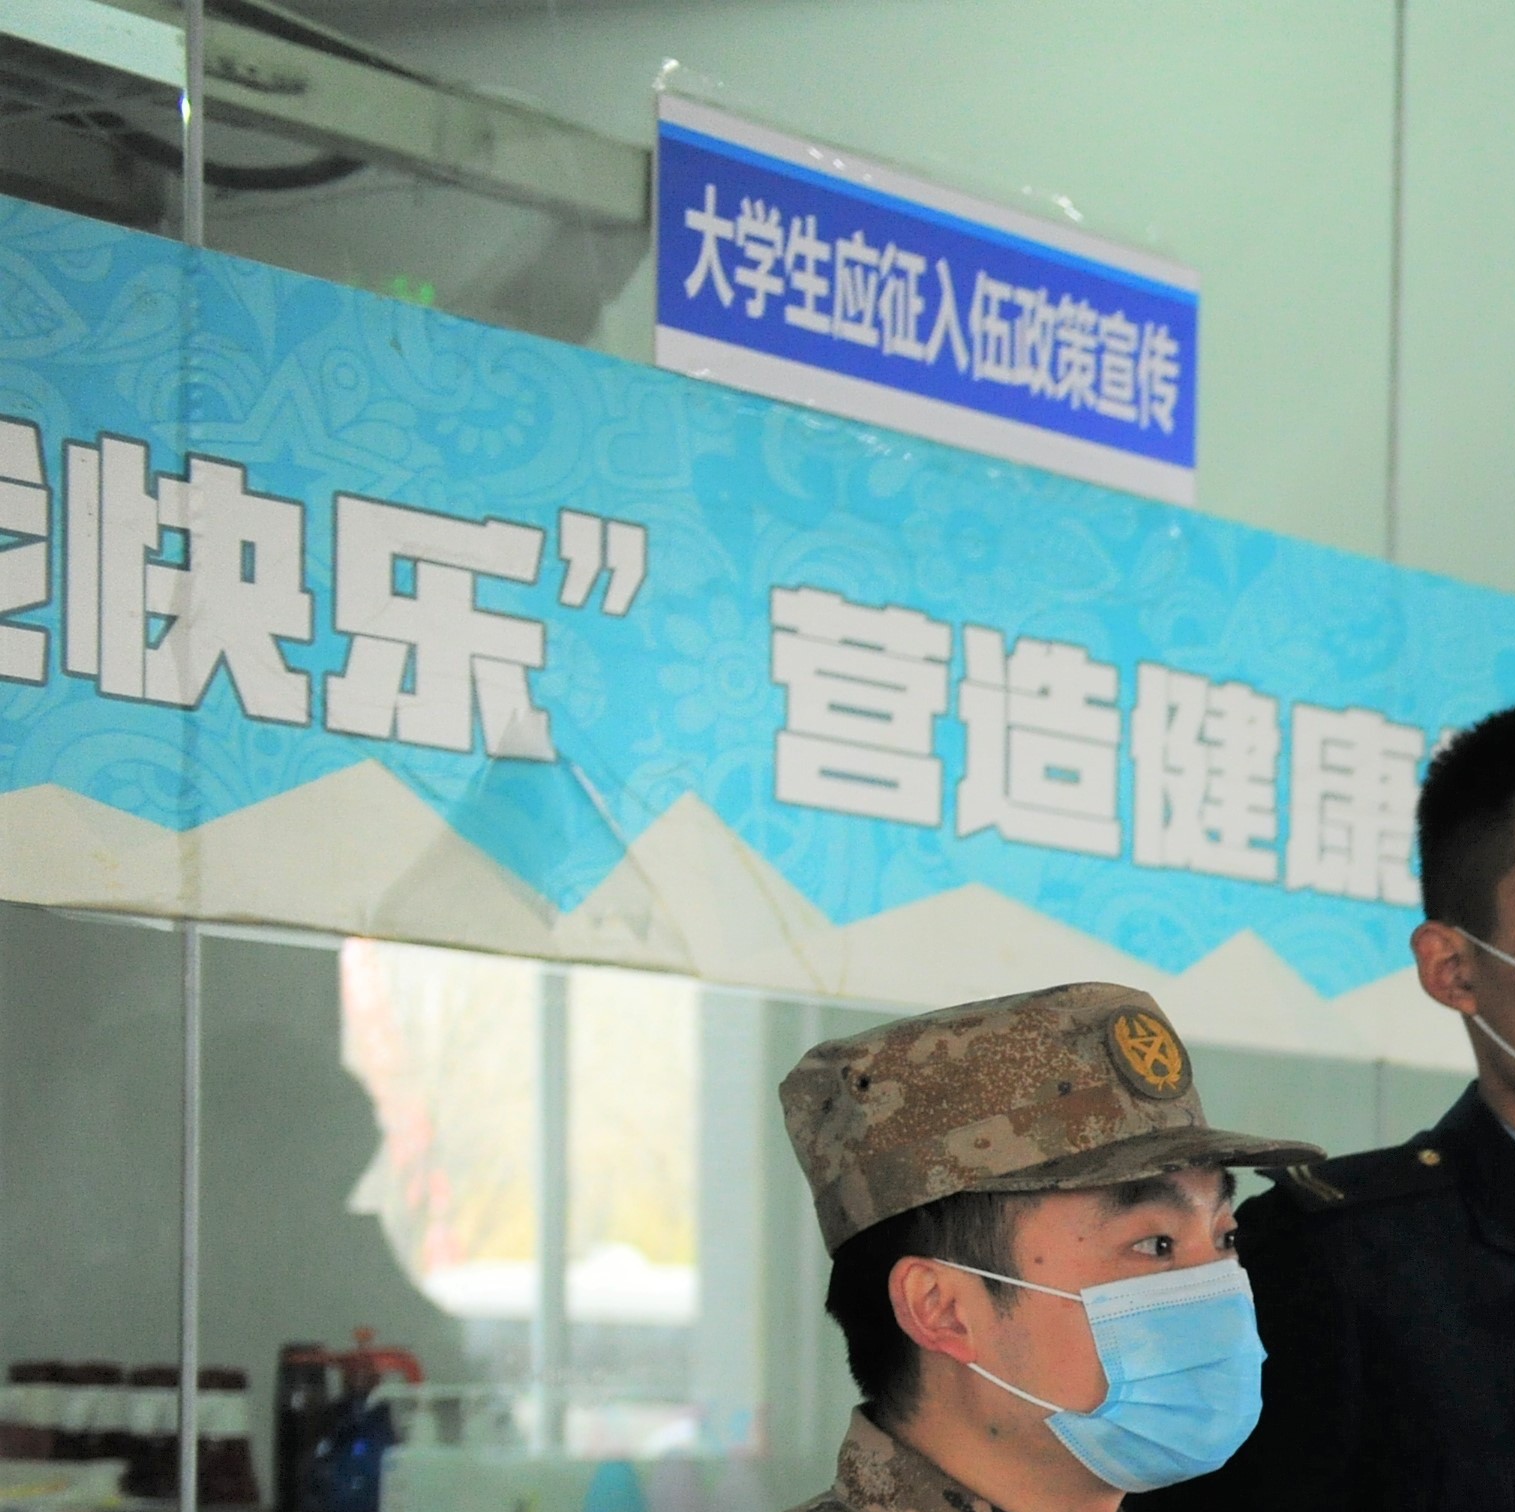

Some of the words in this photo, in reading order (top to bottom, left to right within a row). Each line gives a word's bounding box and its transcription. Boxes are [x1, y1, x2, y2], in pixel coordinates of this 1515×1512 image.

[684, 183, 1182, 436] 大学生应征入伍政策宣传
[768, 585, 1465, 908] 营造健康
